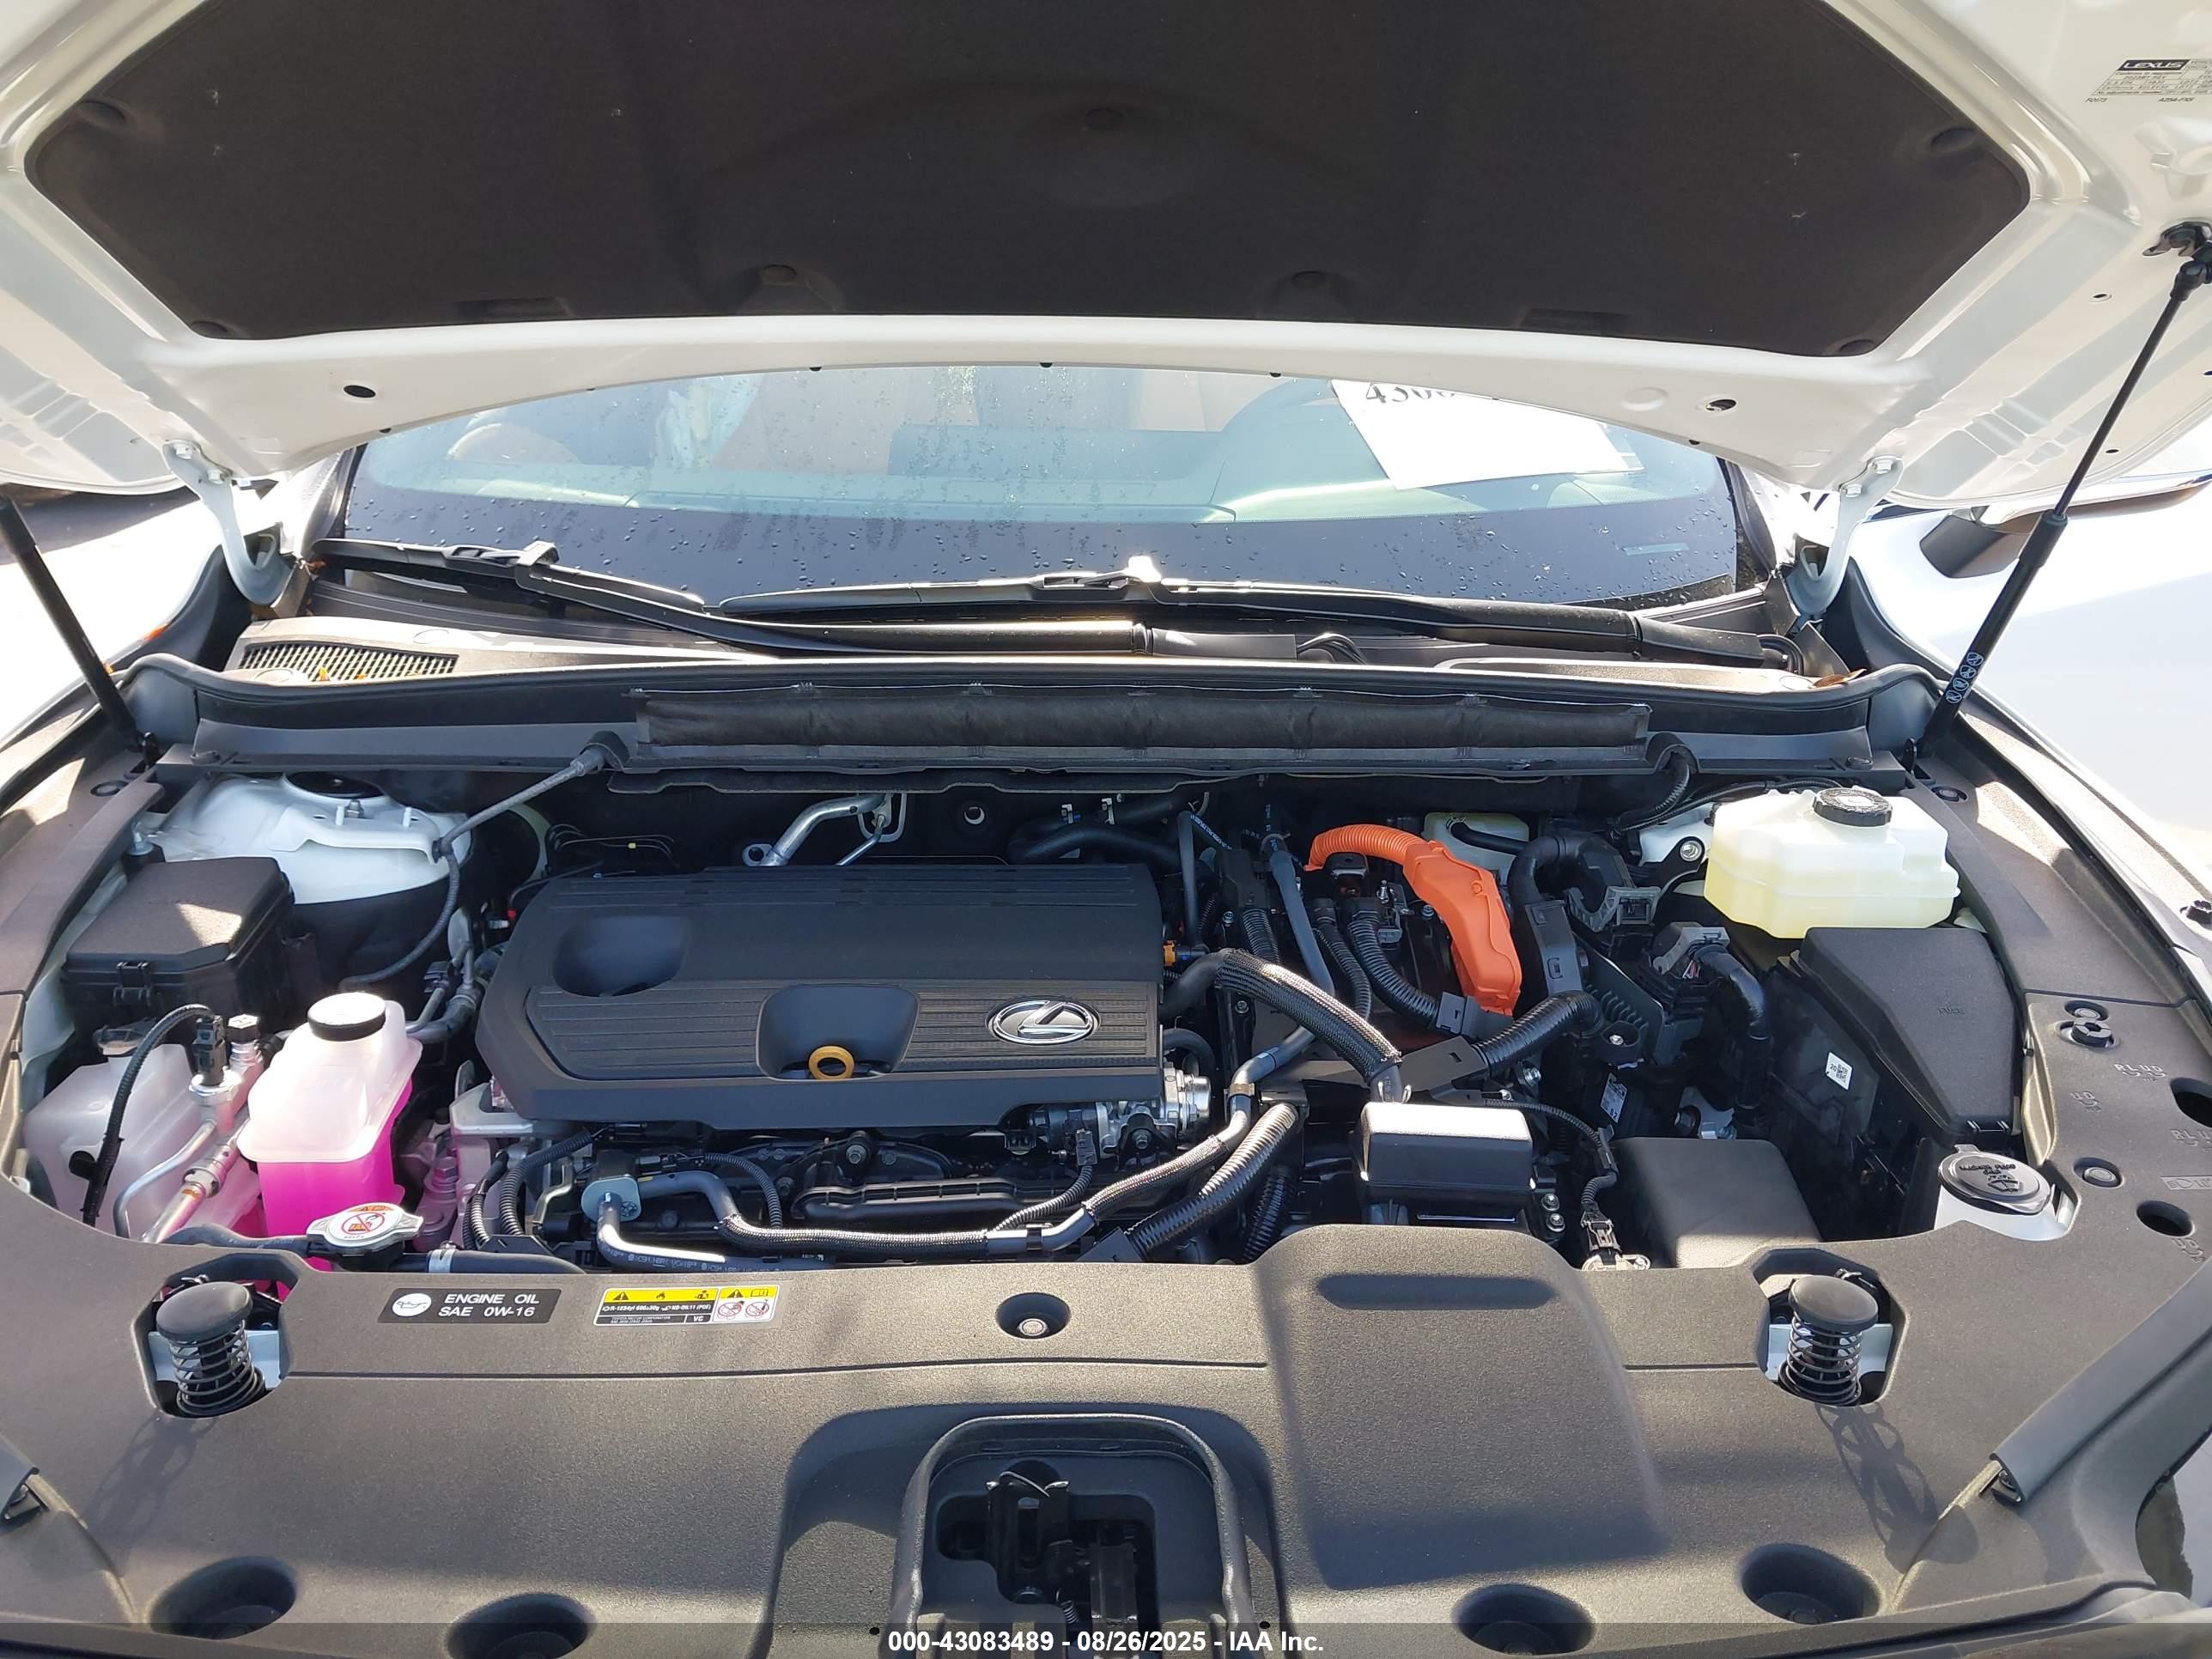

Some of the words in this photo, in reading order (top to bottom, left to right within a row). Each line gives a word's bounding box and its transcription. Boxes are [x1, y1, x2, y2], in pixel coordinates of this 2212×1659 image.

[444, 1294, 505, 1304] ENGINE
[514, 1294, 540, 1304] OIL
[438, 1307, 472, 1317] SAE
[483, 1307, 535, 1317] 0W-16
